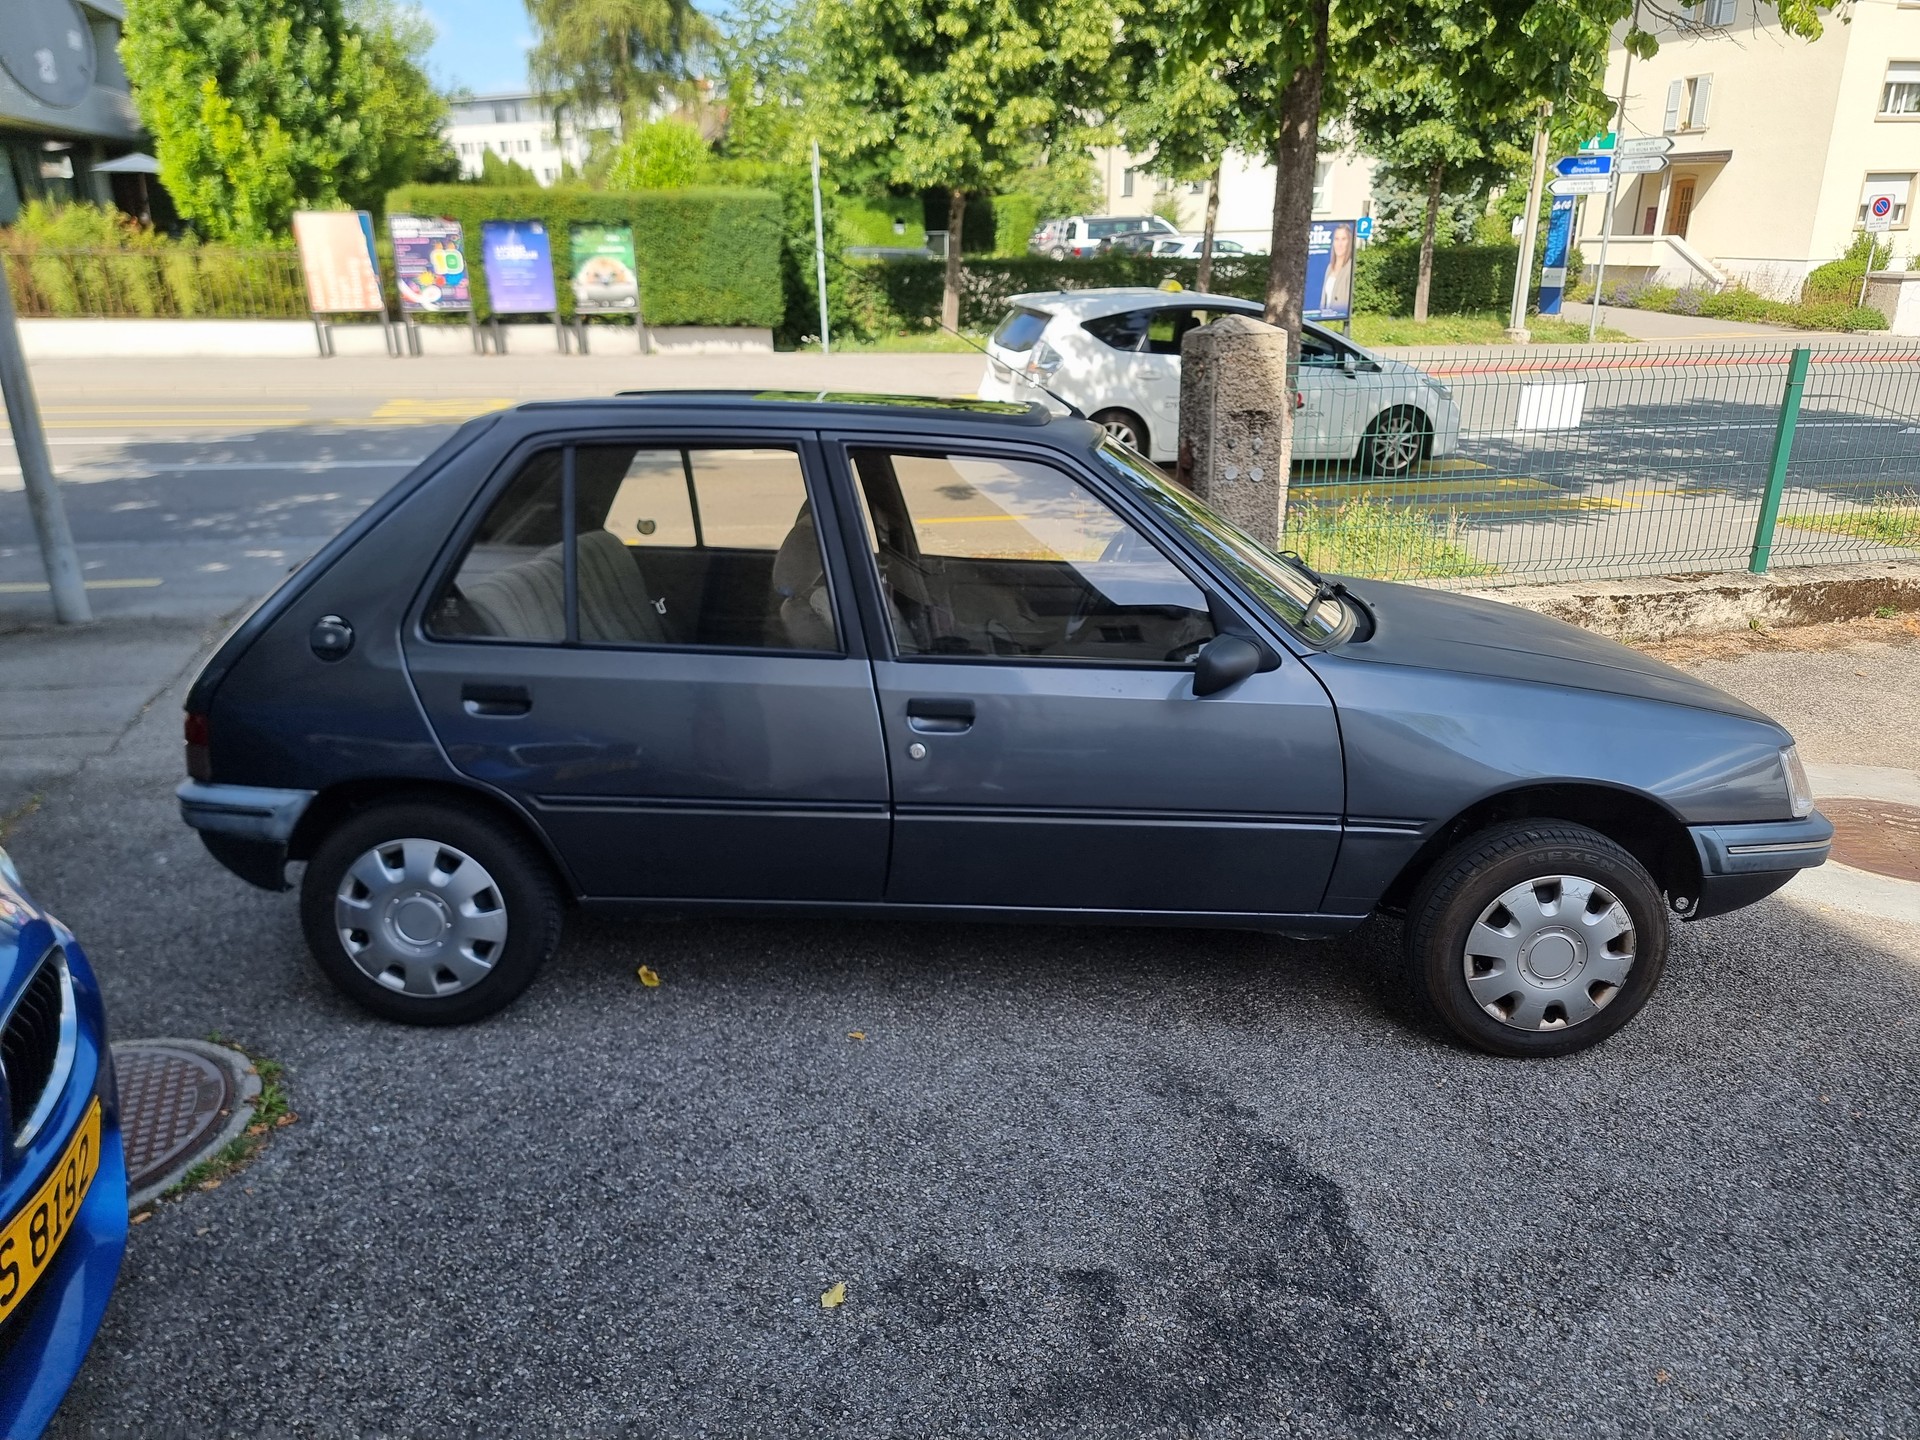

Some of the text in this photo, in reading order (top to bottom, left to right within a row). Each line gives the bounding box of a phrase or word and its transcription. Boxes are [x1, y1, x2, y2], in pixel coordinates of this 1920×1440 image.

[1570, 166, 1600, 174] directions
[1528, 851, 1616, 871] NEXEN
[29, 1133, 89, 1269] 8192
